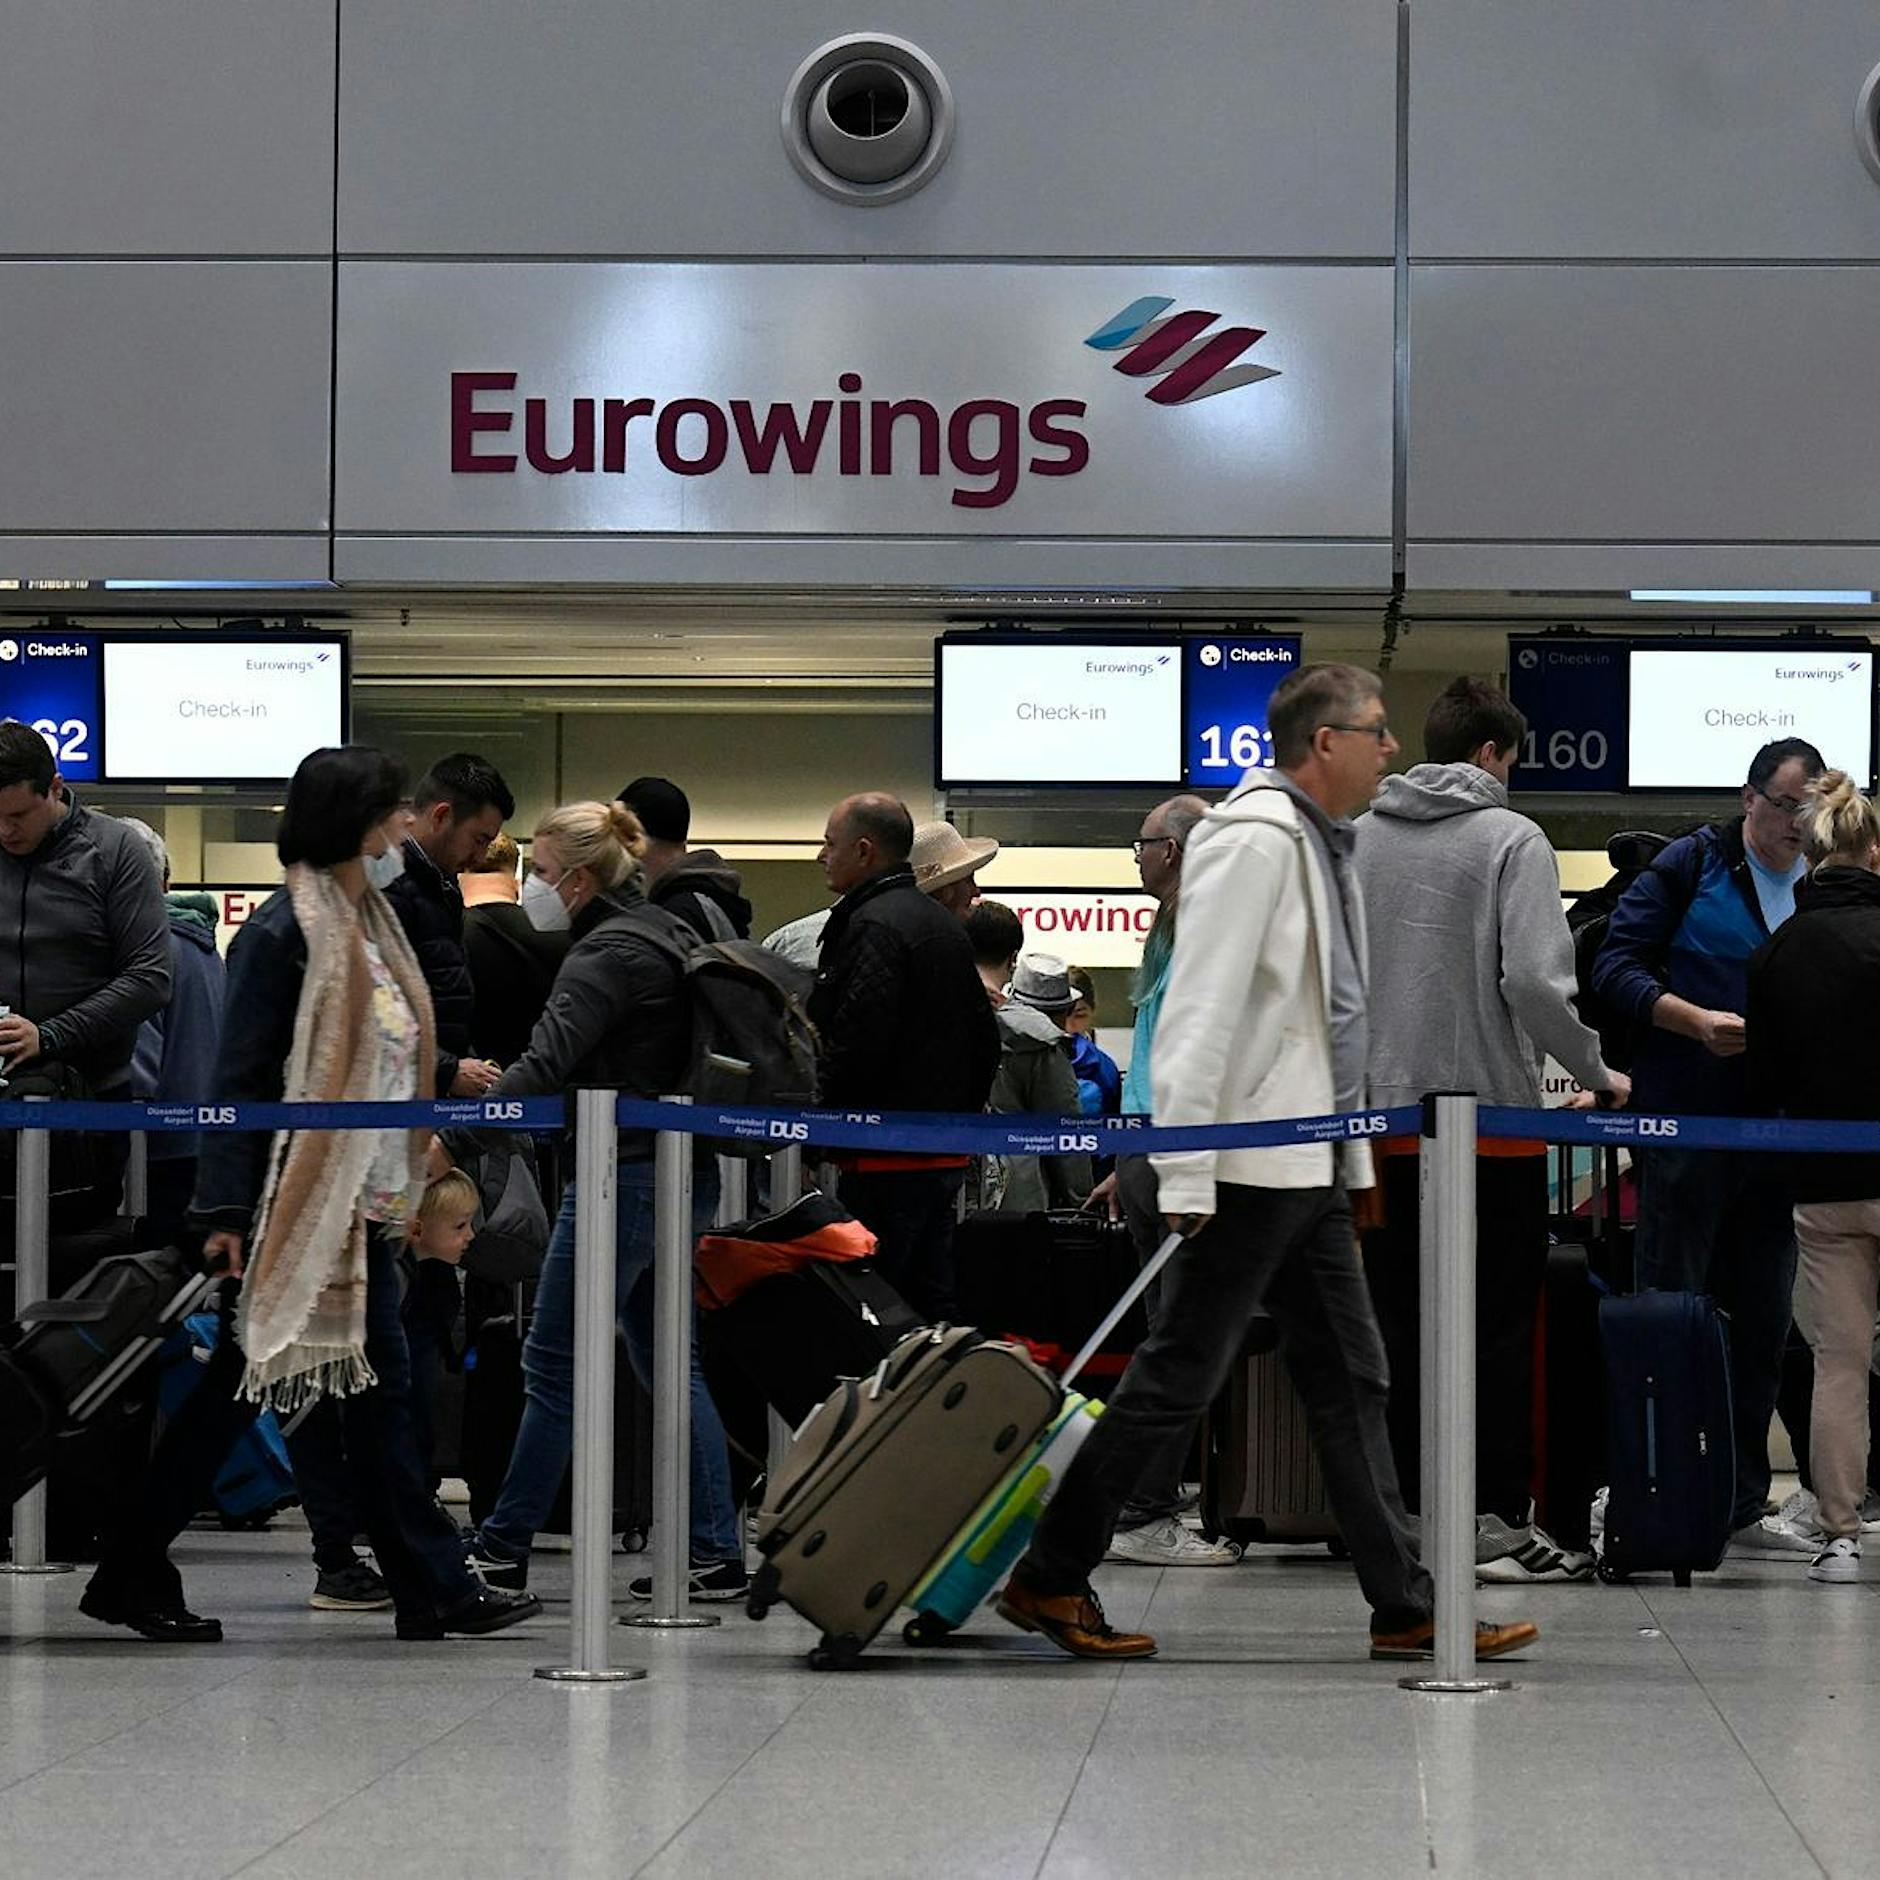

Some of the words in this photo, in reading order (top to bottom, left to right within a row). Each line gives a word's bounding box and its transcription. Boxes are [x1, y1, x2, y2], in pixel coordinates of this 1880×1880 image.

[451, 372, 1090, 509] Eurowings
[28, 643, 87, 656] Check-in
[1230, 648, 1292, 662] Check-in
[1548, 650, 1610, 665] Check-in
[246, 659, 313, 671] Eurowings
[1086, 661, 1154, 676] Eurowings
[1775, 667, 1844, 682] Eurowings
[179, 700, 267, 718] Check-in
[1016, 702, 1107, 721] Check-in
[1705, 709, 1795, 727] Check-in
[3, 718, 89, 761] 62
[1519, 730, 1608, 770] 160
[198, 1107, 236, 1124] DUS
[485, 1102, 523, 1120] DUS
[769, 1120, 809, 1140] DUS
[1348, 1115, 1389, 1135] DUS
[1639, 1118, 1678, 1136] DUS
[1058, 1134, 1098, 1151] DUS
